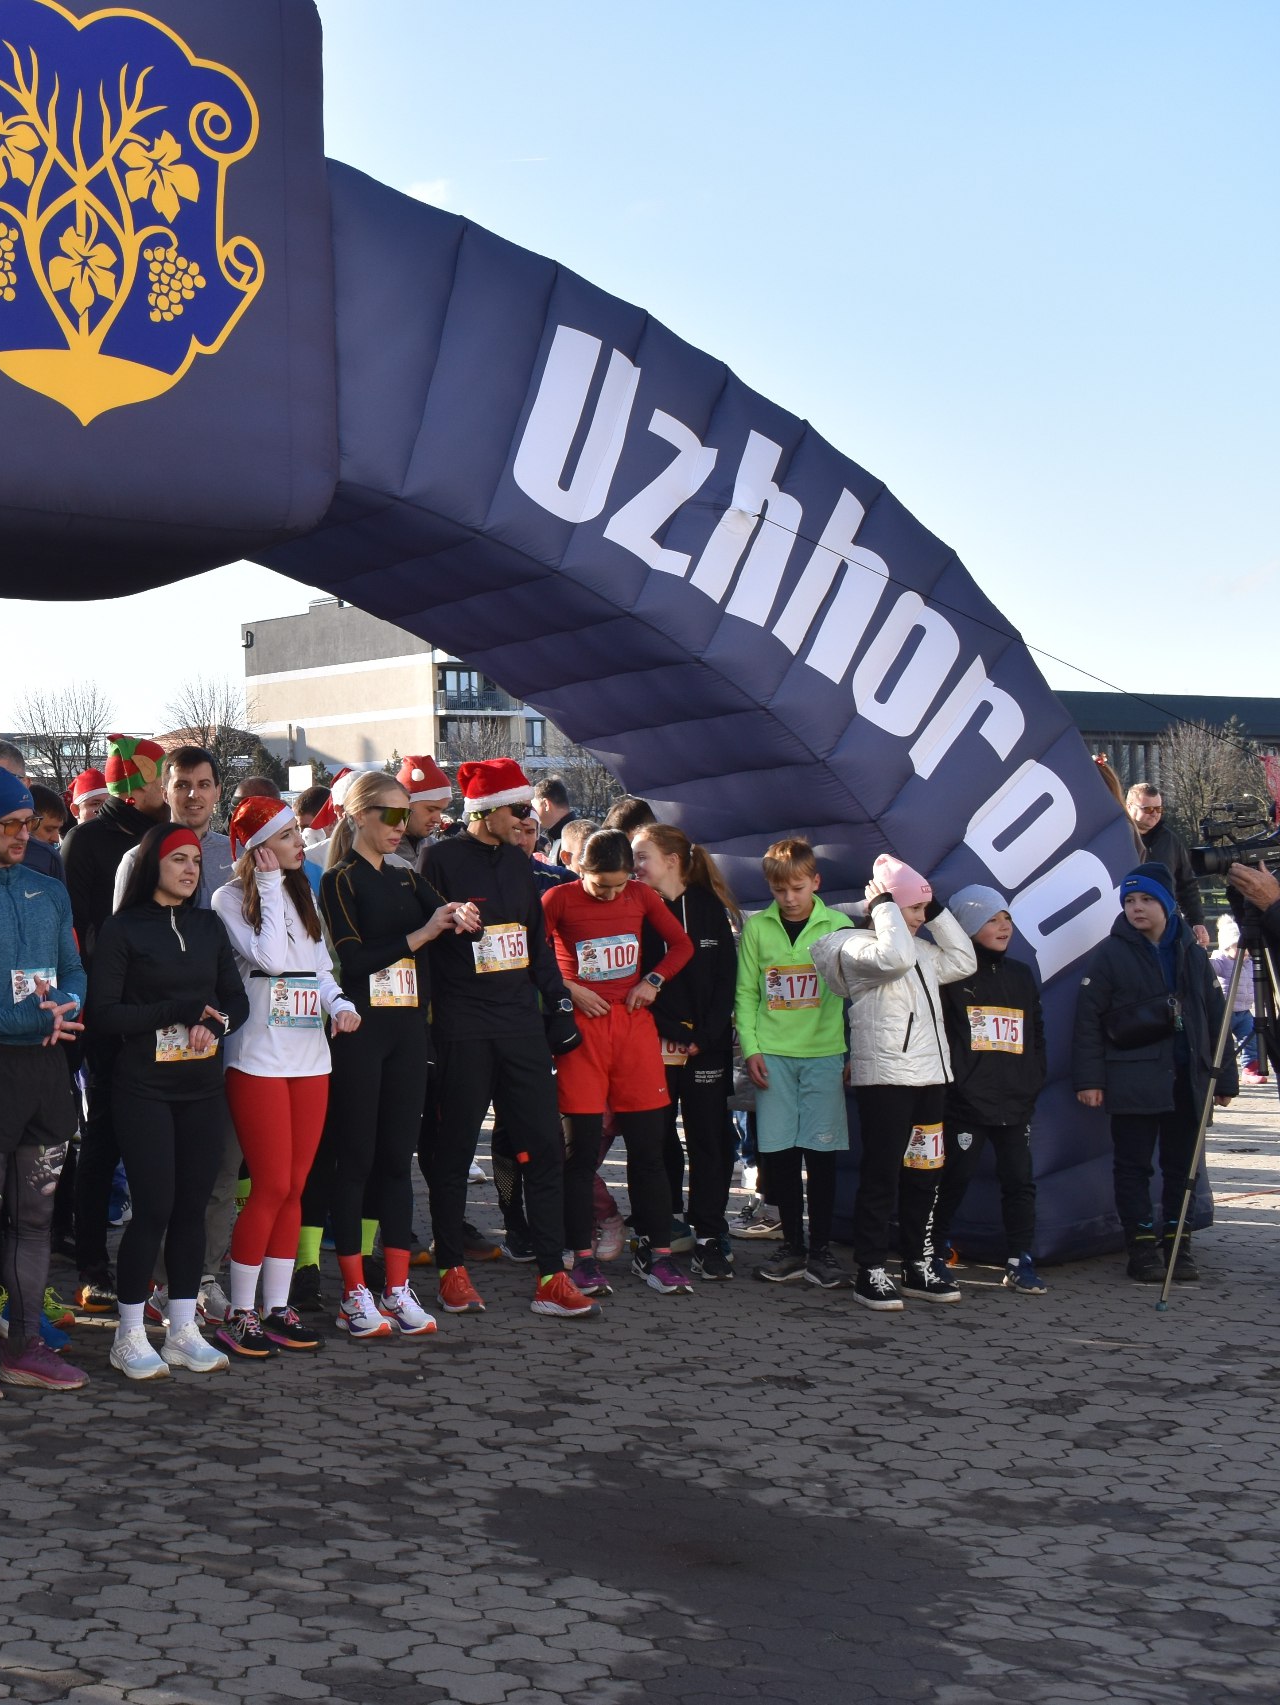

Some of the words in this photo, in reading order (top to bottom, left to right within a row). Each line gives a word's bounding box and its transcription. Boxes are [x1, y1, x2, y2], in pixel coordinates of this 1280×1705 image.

[513, 324, 1121, 984] Uzhhorod
[497, 933, 524, 959] 155
[603, 943, 636, 970] 100
[786, 974, 818, 999] 177
[293, 990, 318, 1016] 112
[992, 1017, 1019, 1042] 175
